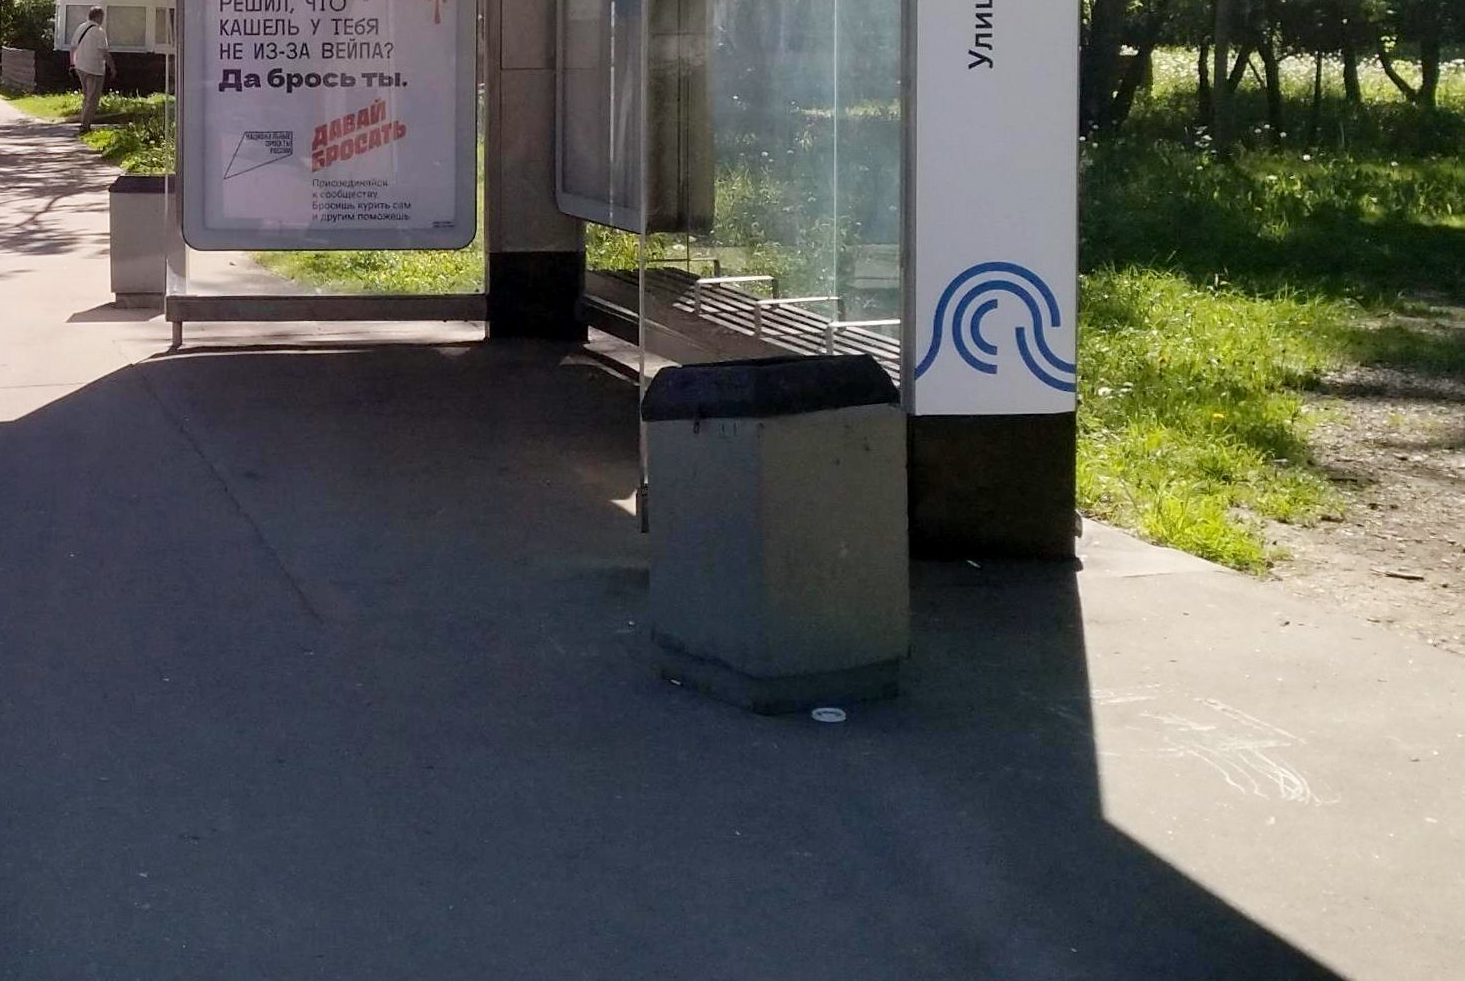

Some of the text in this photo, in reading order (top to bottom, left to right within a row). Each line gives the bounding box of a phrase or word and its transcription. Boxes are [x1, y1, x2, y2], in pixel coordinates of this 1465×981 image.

[220, 19, 299, 36] КАШЕЛЬ
[311, 19, 321, 36] У
[220, 38, 394, 60] НЕ ИЗ-ЗА ВЕЙПА?
[218, 68, 408, 94] Да брось ты.
[312, 97, 387, 151] ДАВАЙ
[312, 120, 407, 172] БРОСАТЬ
